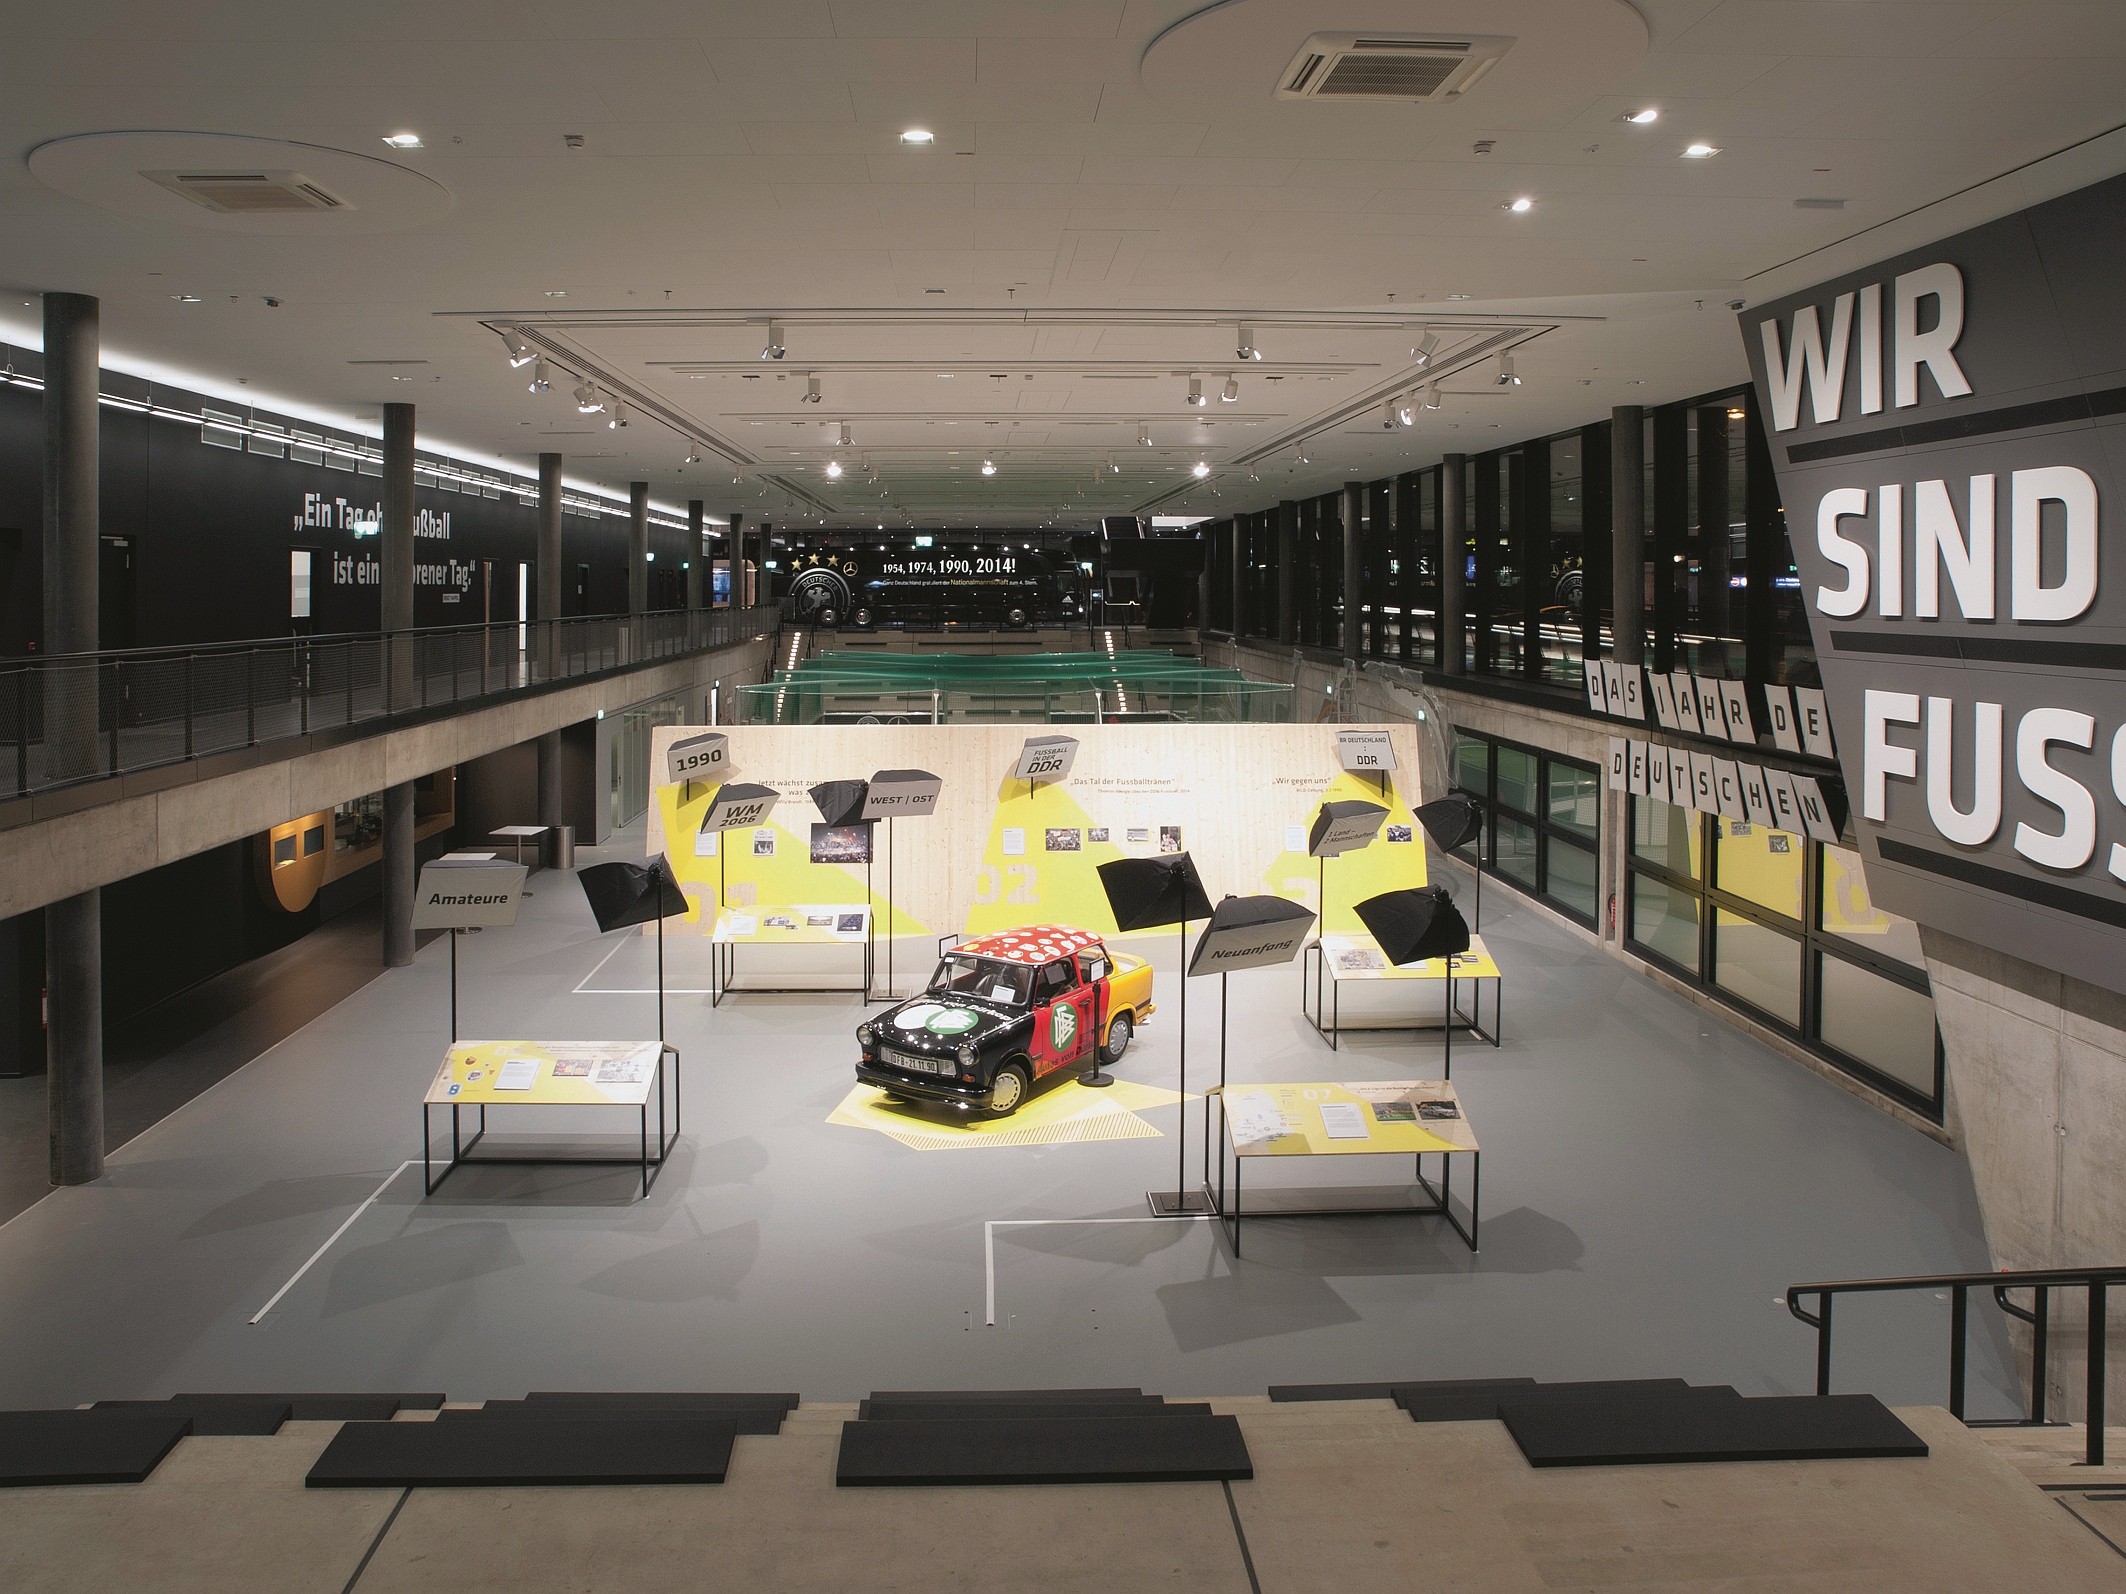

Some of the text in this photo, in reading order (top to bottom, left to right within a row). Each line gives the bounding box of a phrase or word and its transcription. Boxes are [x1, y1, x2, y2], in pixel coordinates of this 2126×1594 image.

[1760, 261, 1973, 432] WIR
[413, 509, 450, 539] ußball
[1816, 465, 2099, 622] SIND
[333, 551, 353, 584] ist
[357, 553, 380, 584] ein
[883, 557, 1016, 575] 1954, 1974, 1990, 2014!
[802, 577, 839, 592] DEUTSCHER
[1591, 675, 1820, 736] DAS JAHR DE
[1034, 747, 1069, 756] FUSSBALL
[677, 749, 723, 772] 1990
[1026, 759, 1063, 774] DDR
[1357, 755, 1379, 765] DDR
[778, 779, 804, 787] wächst
[1291, 778, 1313, 786] gegen
[1614, 752, 1822, 823] DEUTSCHEN
[870, 796, 902, 805] WEST
[912, 795, 934, 804] OST
[726, 803, 763, 818] WM
[719, 814, 758, 827] 2006
[1334, 829, 1351, 837] Land
[967, 863, 1040, 905] 02
[429, 893, 509, 905] Amateure
[1211, 938, 1294, 960] Neuanfang
